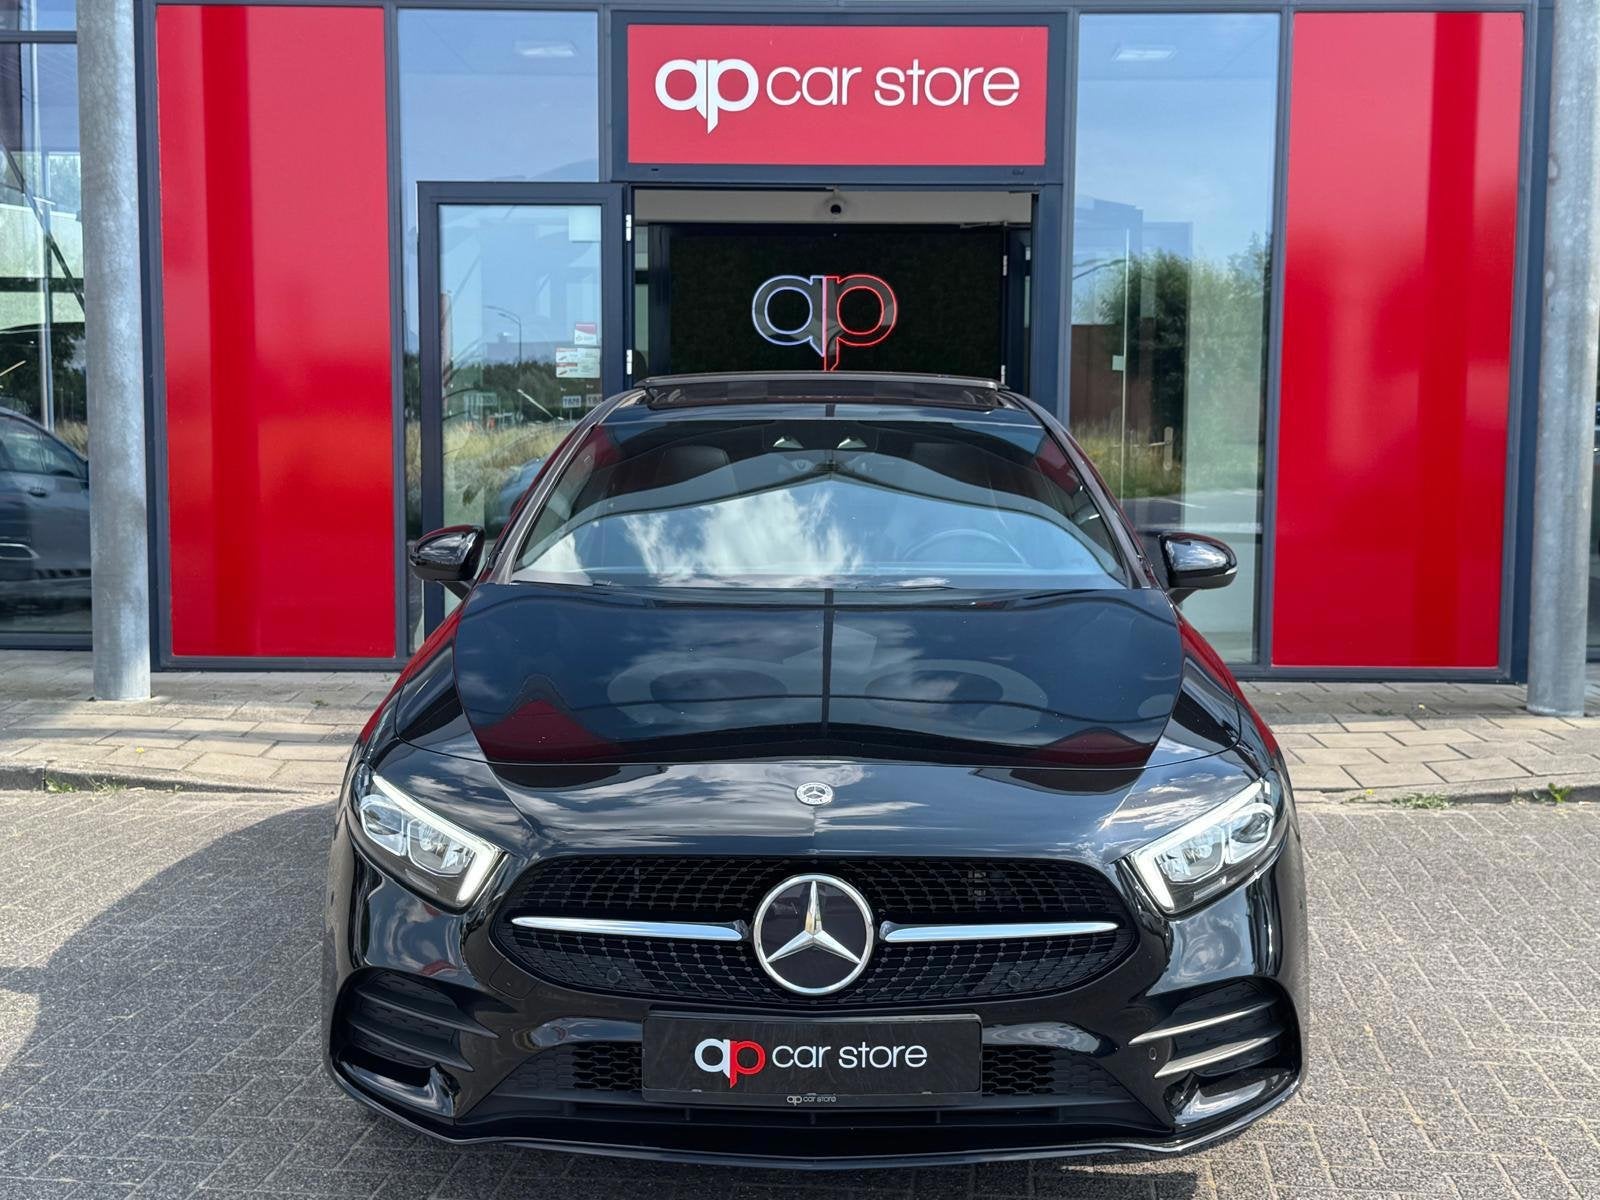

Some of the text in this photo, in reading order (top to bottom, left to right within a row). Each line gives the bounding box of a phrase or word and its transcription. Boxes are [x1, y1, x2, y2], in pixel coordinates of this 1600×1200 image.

[655, 58, 1020, 134] ap car store
[751, 273, 898, 371] ap
[694, 1038, 928, 1088] ap car store
